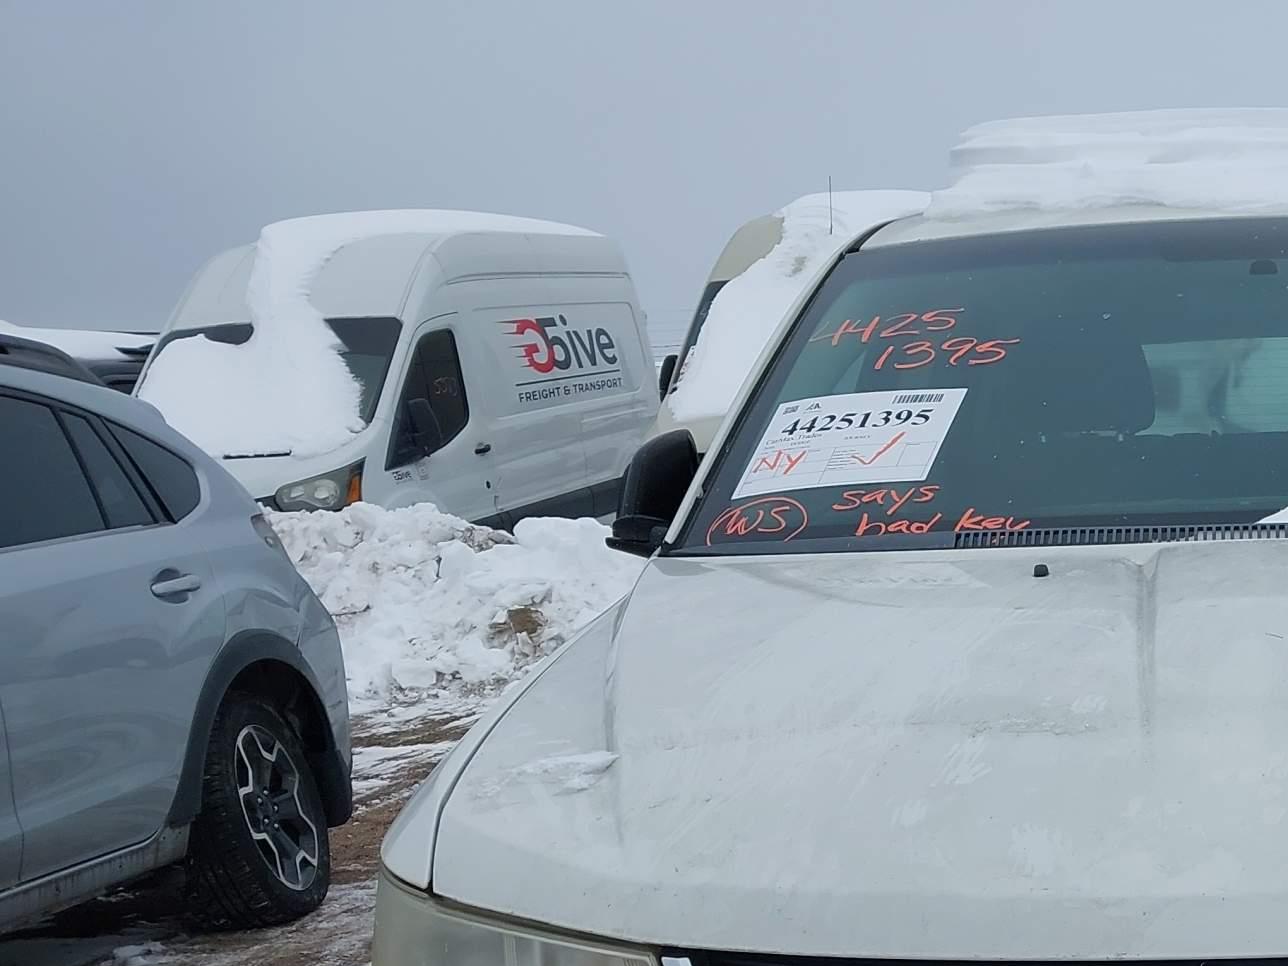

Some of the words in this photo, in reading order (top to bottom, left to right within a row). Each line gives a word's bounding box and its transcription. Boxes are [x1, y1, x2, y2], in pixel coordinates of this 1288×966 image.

[810, 308, 965, 345] 4425
[873, 337, 1021, 371] 1395
[518, 386, 562, 403] FREIGHT
[563, 385, 571, 396] &
[572, 377, 623, 394] TRANSPORT
[781, 408, 934, 436] 44251395
[752, 449, 807, 475] NY
[832, 485, 941, 515] says
